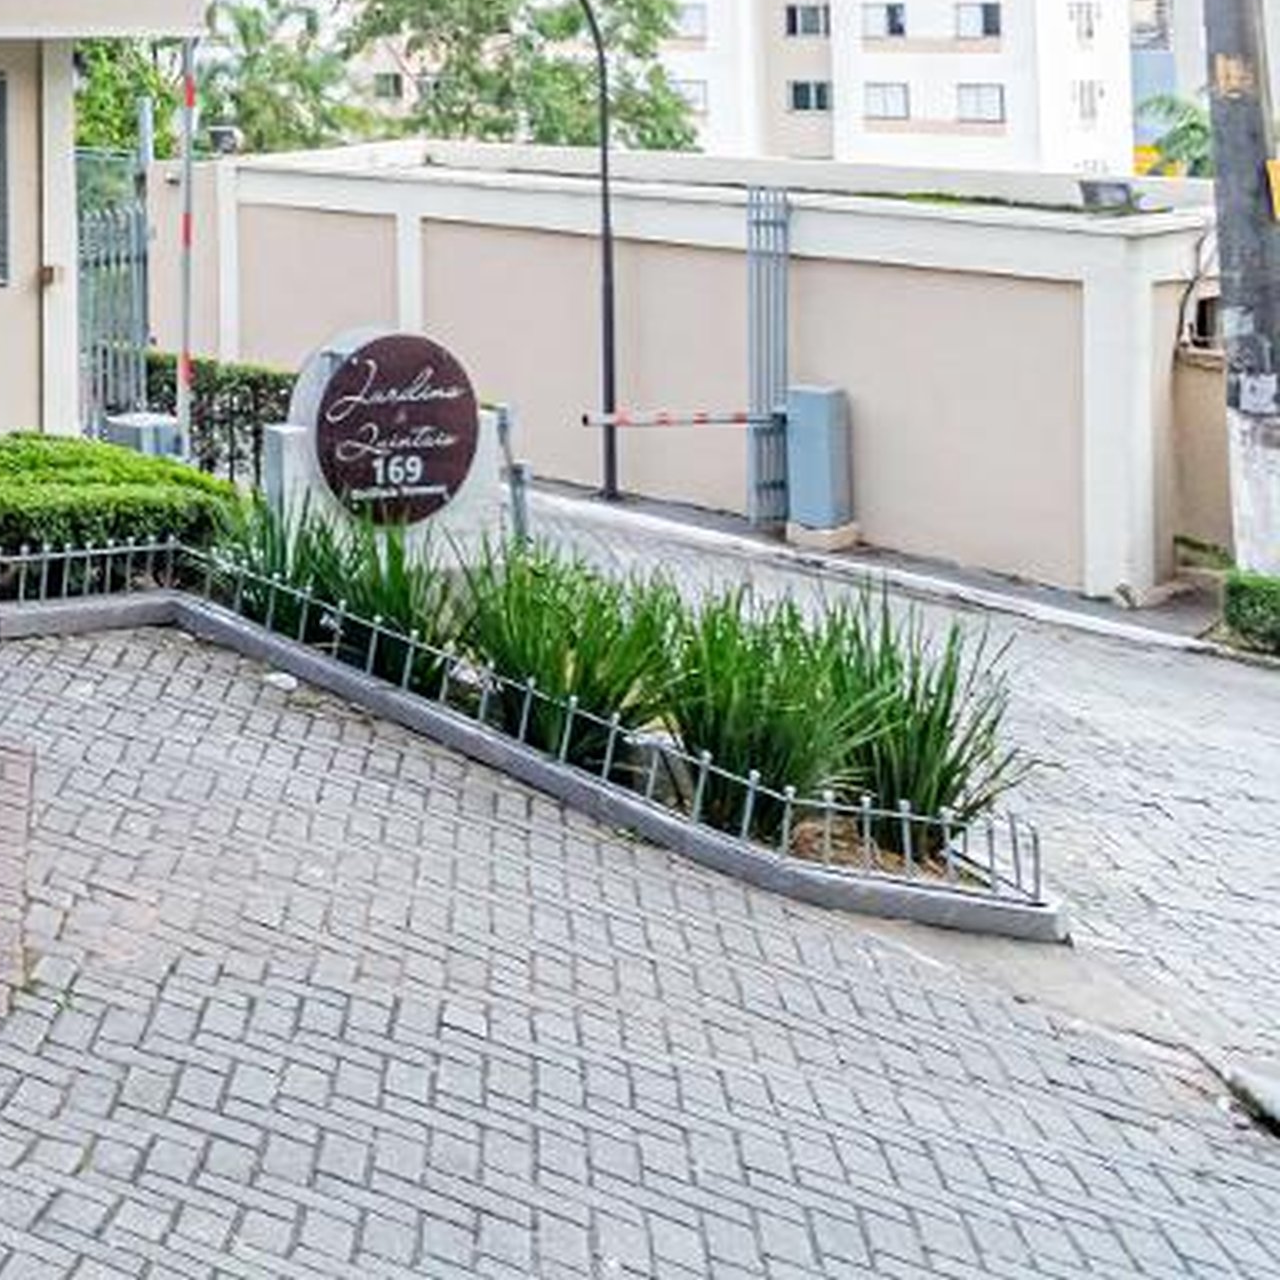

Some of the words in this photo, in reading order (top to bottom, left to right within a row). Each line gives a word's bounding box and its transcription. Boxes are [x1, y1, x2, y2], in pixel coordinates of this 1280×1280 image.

[325, 358, 463, 423] Jardins
[336, 422, 458, 461] Quintais
[372, 455, 423, 486] 169
